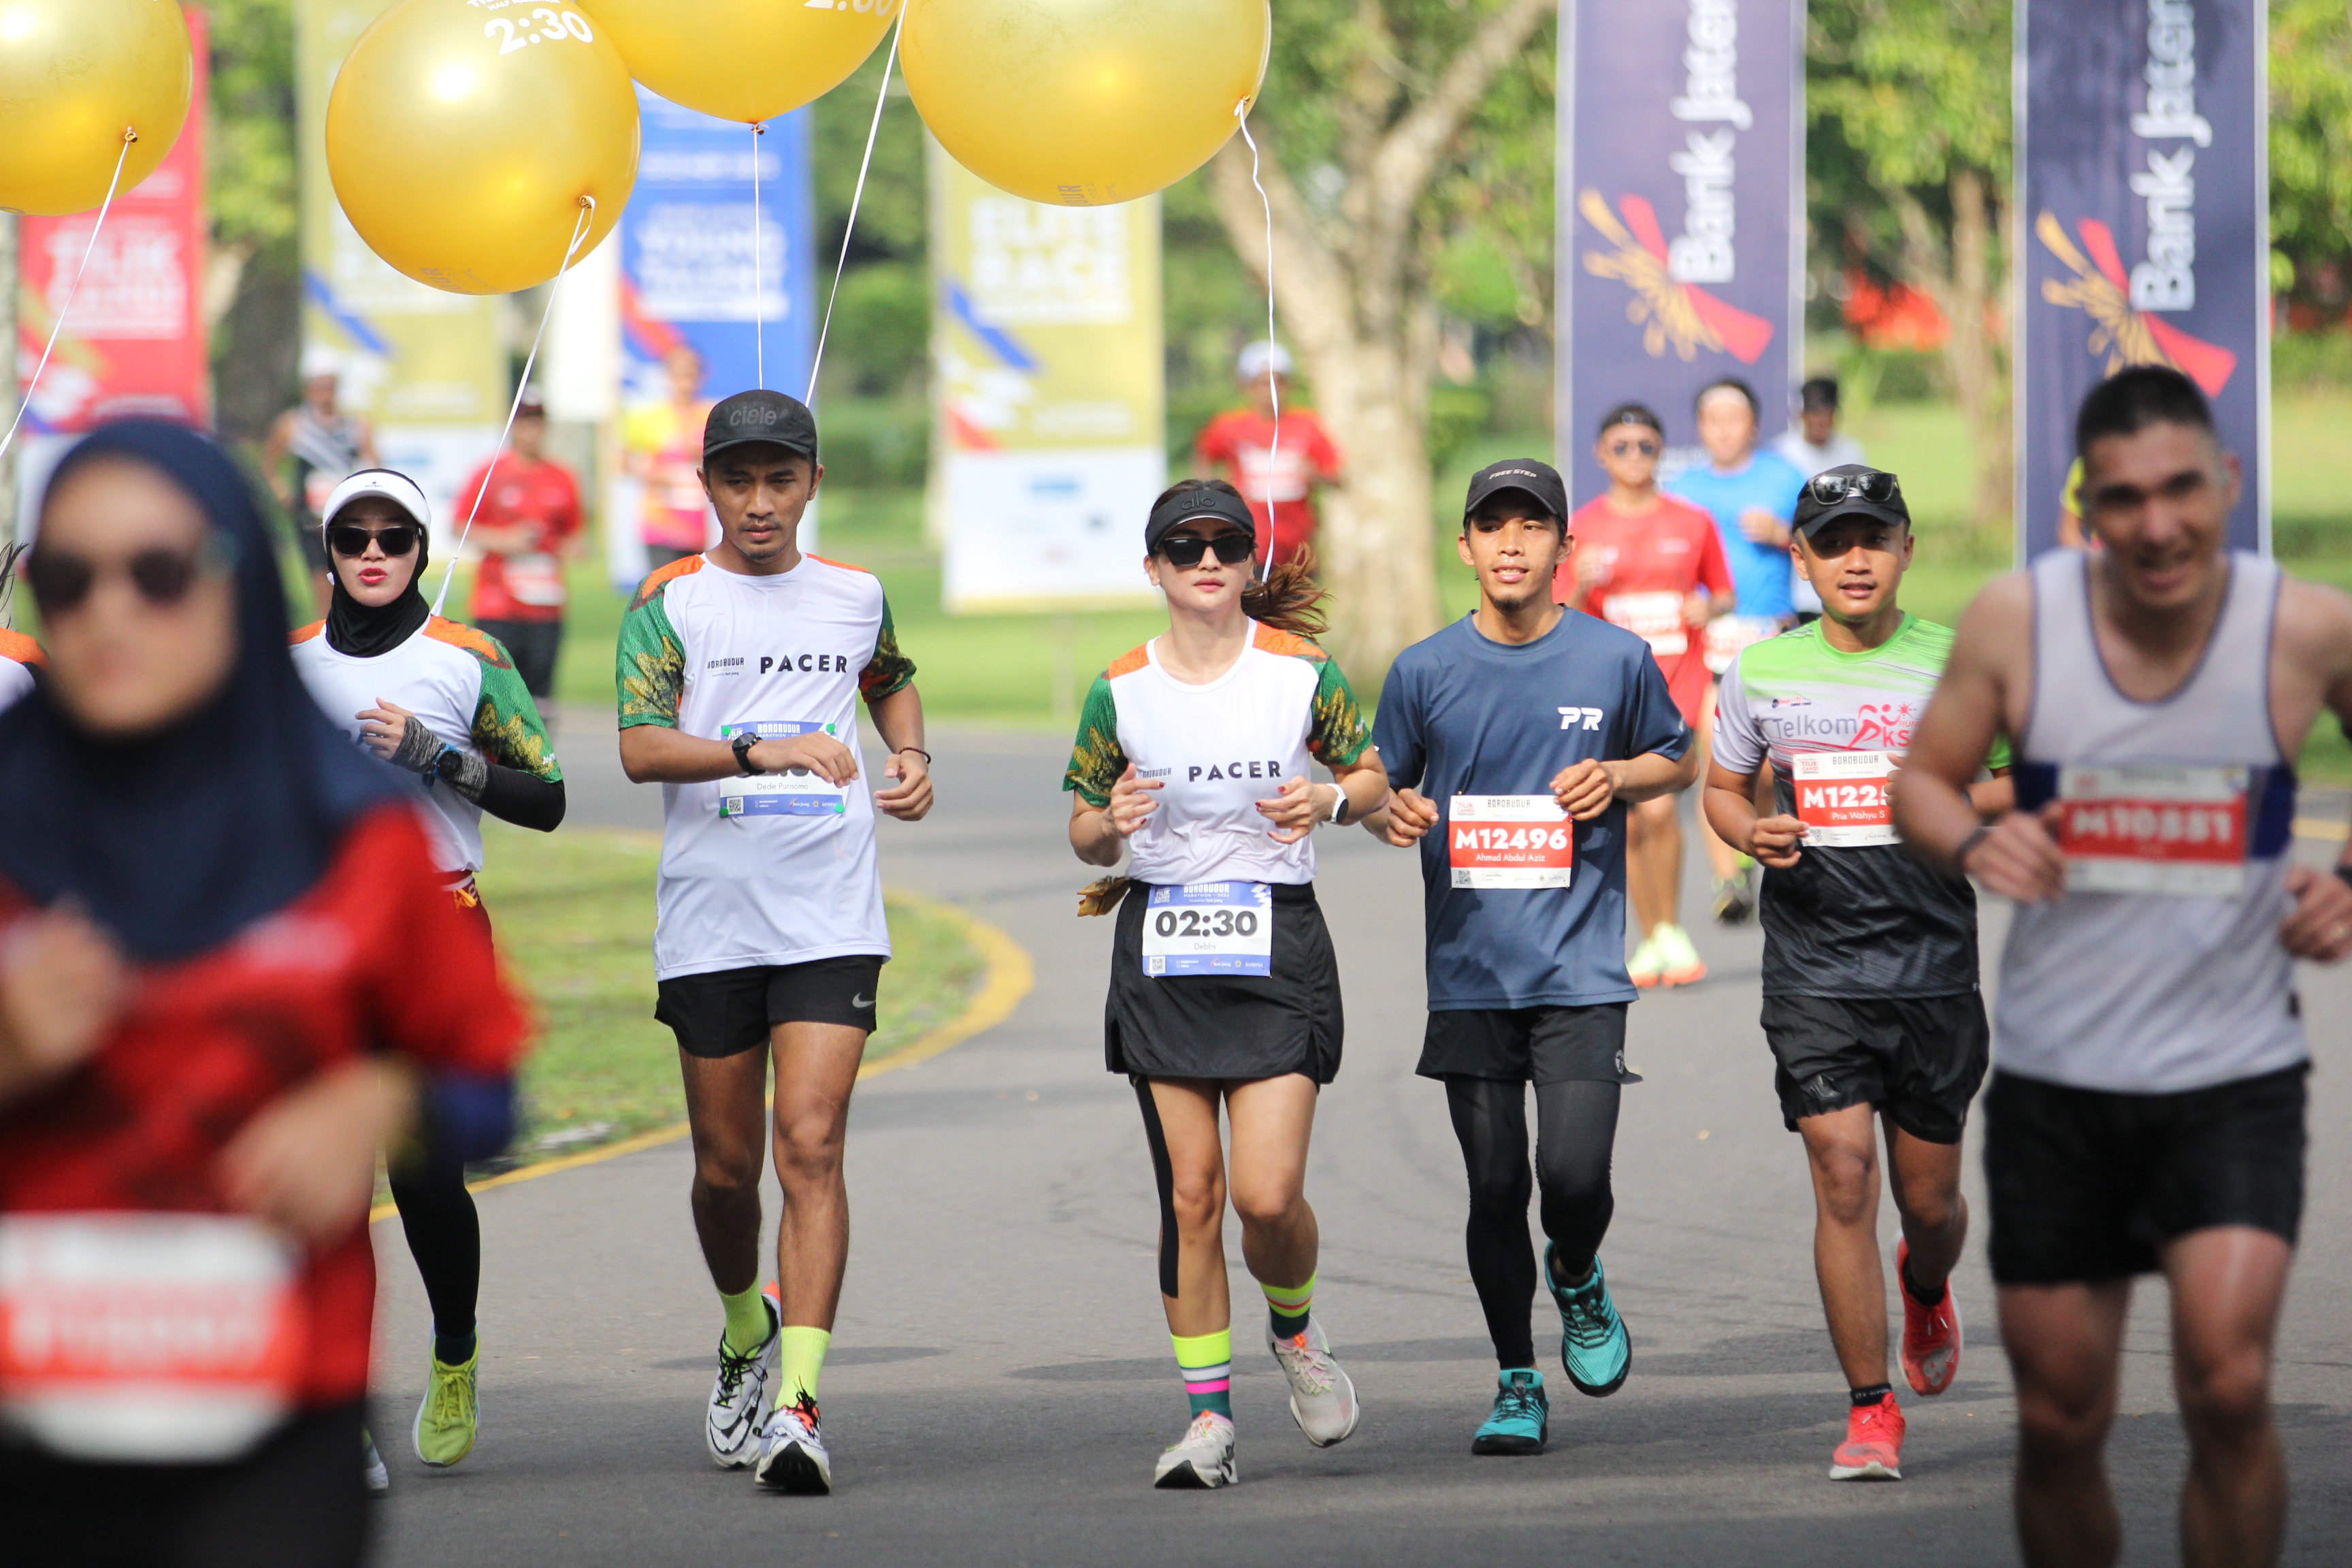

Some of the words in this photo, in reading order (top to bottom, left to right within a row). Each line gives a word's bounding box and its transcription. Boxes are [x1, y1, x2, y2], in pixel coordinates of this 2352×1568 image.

[484, 8, 593, 56] 2:30
[1667, 127, 1735, 283] Bank
[2129, 146, 2195, 312] Bank
[730, 407, 777, 426] ciele
[1489, 470, 1512, 480] FREE
[1513, 469, 1537, 478] STEP
[1181, 491, 1215, 510] alo
[707, 657, 744, 669] BOROBUDUR
[760, 654, 847, 674] PACER
[1558, 706, 1603, 731] PR
[1773, 715, 1857, 738] Telkom
[757, 723, 800, 734] BOROBUDUR
[1833, 755, 1878, 765] BOROBUDUR
[1189, 761, 1281, 782] PACER
[1850, 811, 1877, 821] Wahyu
[1455, 828, 1567, 849] M12496
[1476, 853, 1501, 862] Ahmad
[1503, 853, 1525, 862] Abdul
[1183, 883, 1230, 893] BOROBUDUR
[1156, 910, 1258, 938] 02:30
